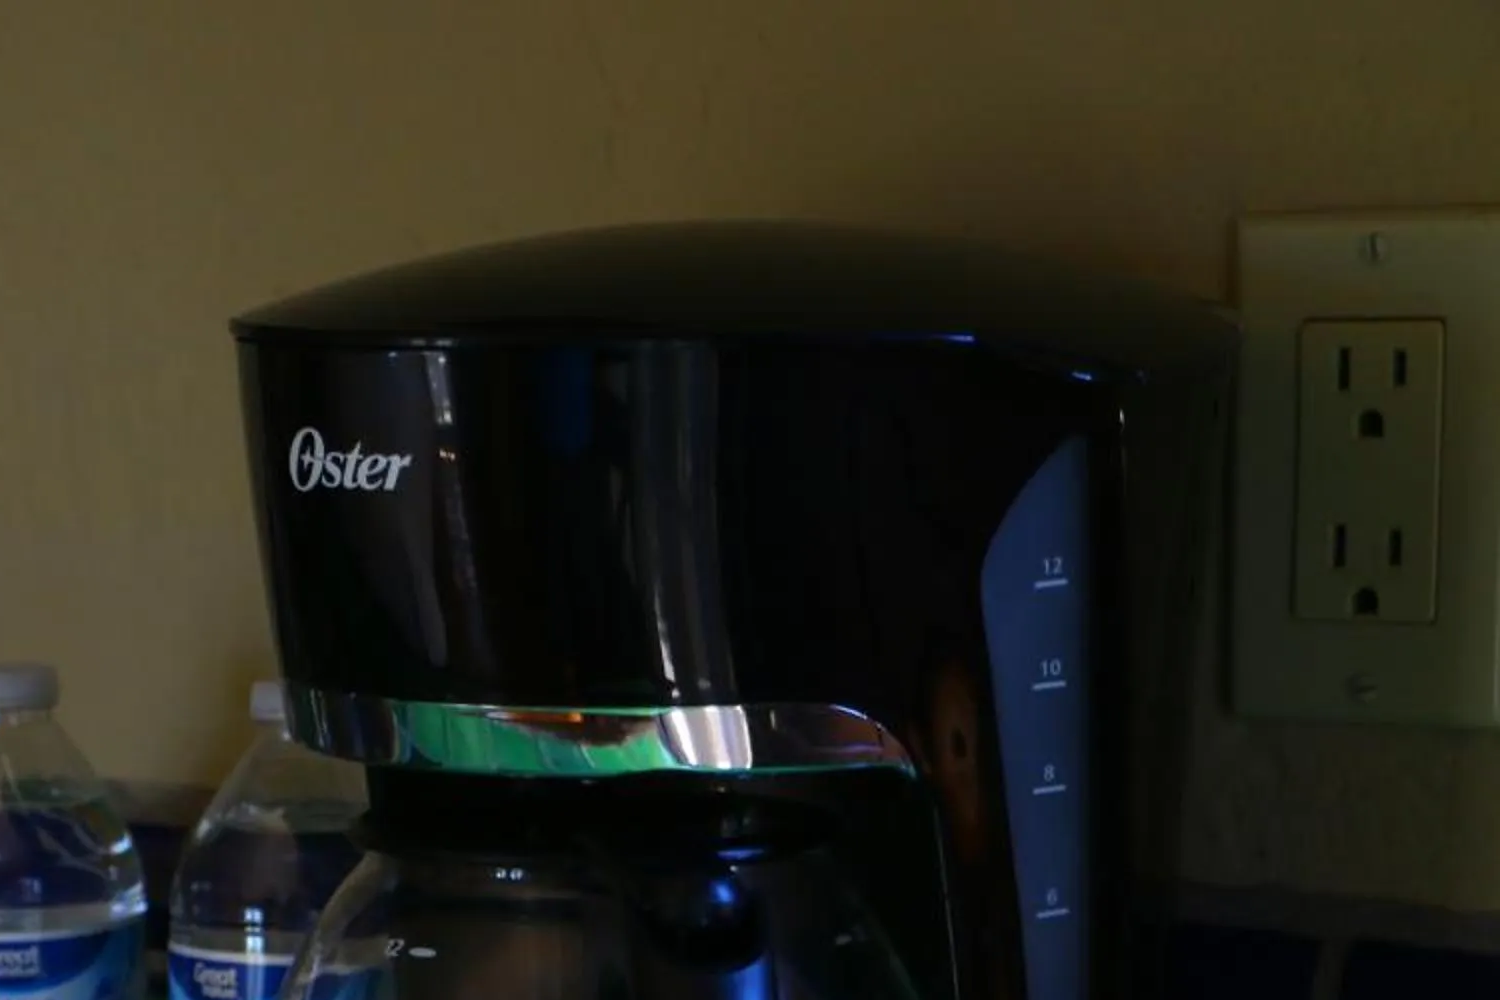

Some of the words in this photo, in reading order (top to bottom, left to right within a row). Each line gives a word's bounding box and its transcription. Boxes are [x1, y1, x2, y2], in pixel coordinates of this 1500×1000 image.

[289, 426, 414, 492] Oster
[1043, 557, 1064, 576] 12
[1040, 658, 1062, 677] 10
[1043, 763, 1055, 782] 8
